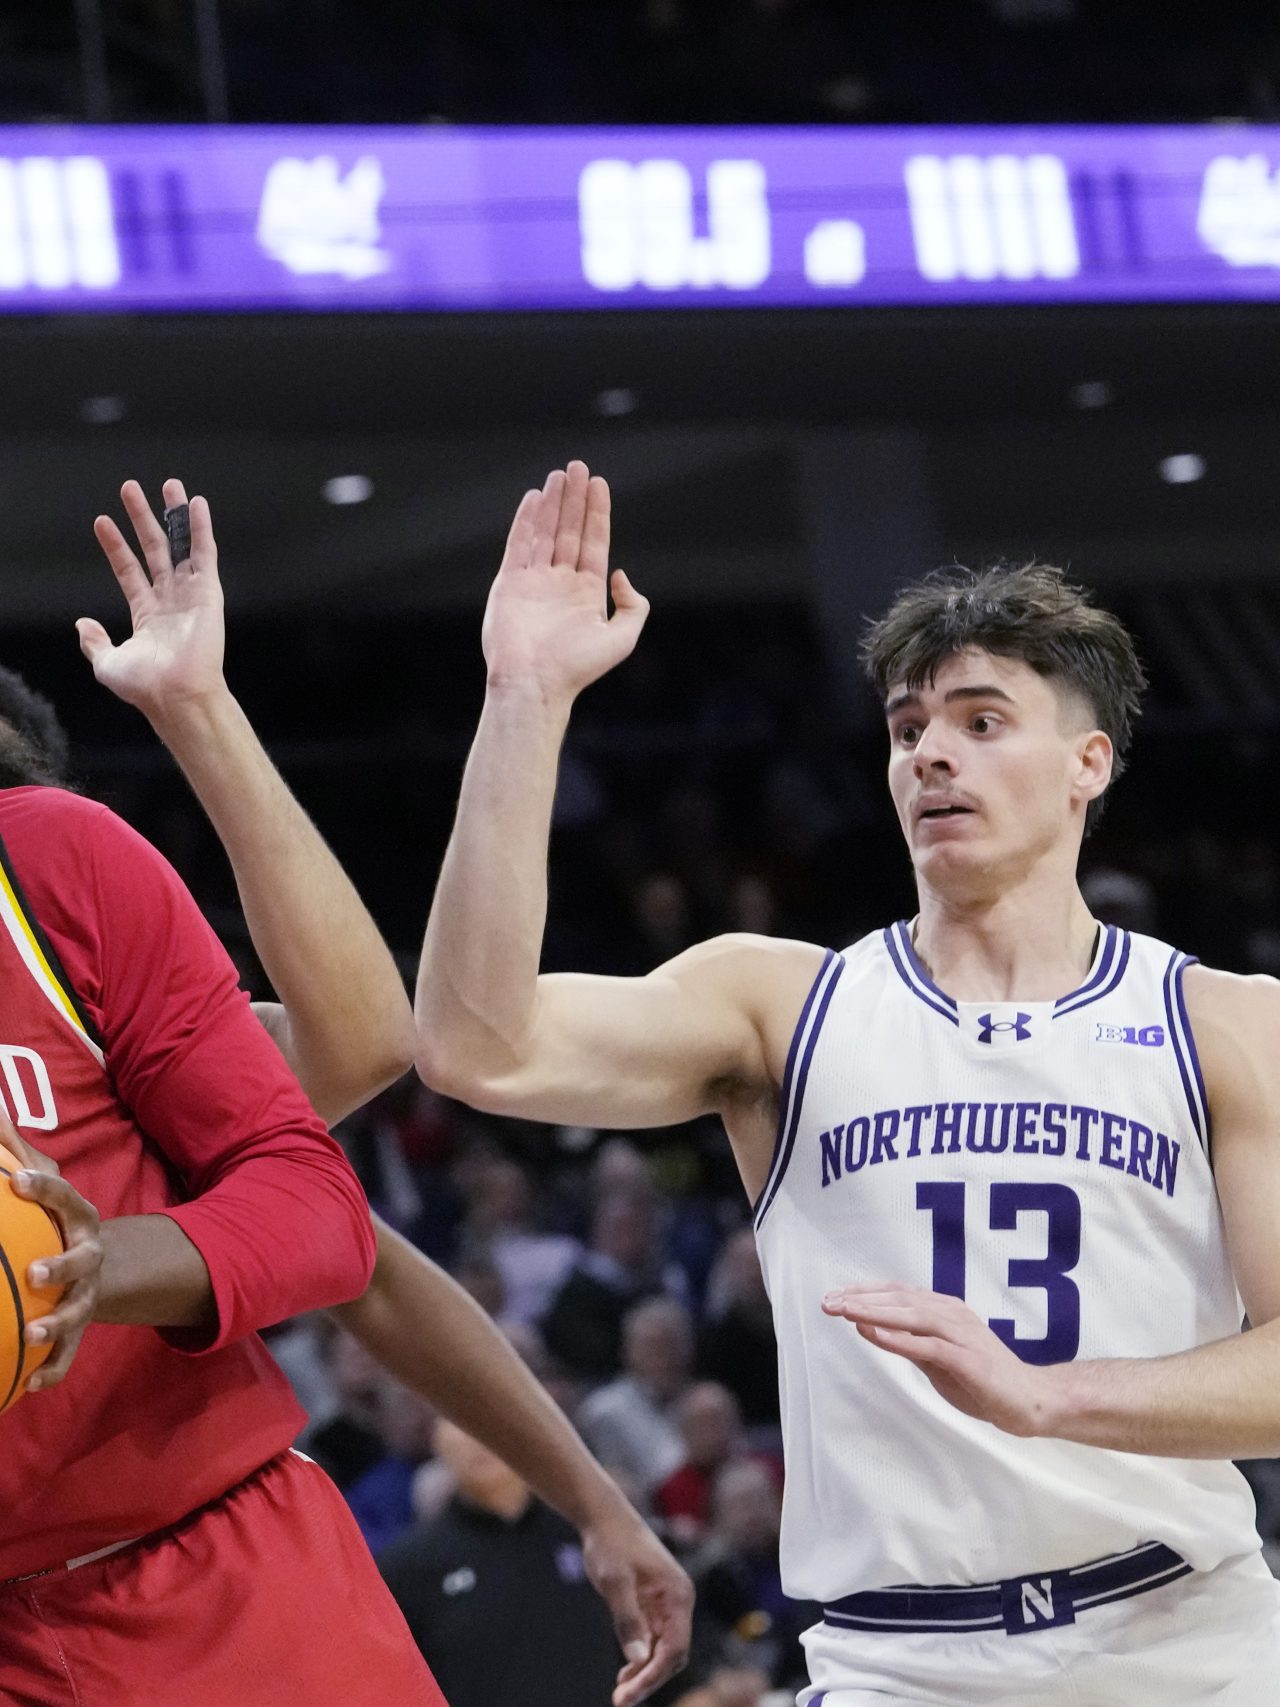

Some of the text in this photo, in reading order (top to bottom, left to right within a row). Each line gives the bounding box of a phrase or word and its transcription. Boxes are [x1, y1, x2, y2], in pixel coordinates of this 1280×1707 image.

[819, 1102, 1181, 1198] NORTHWESTERN
[915, 1181, 1081, 1366] 13
[1021, 1578, 1055, 1624] N
